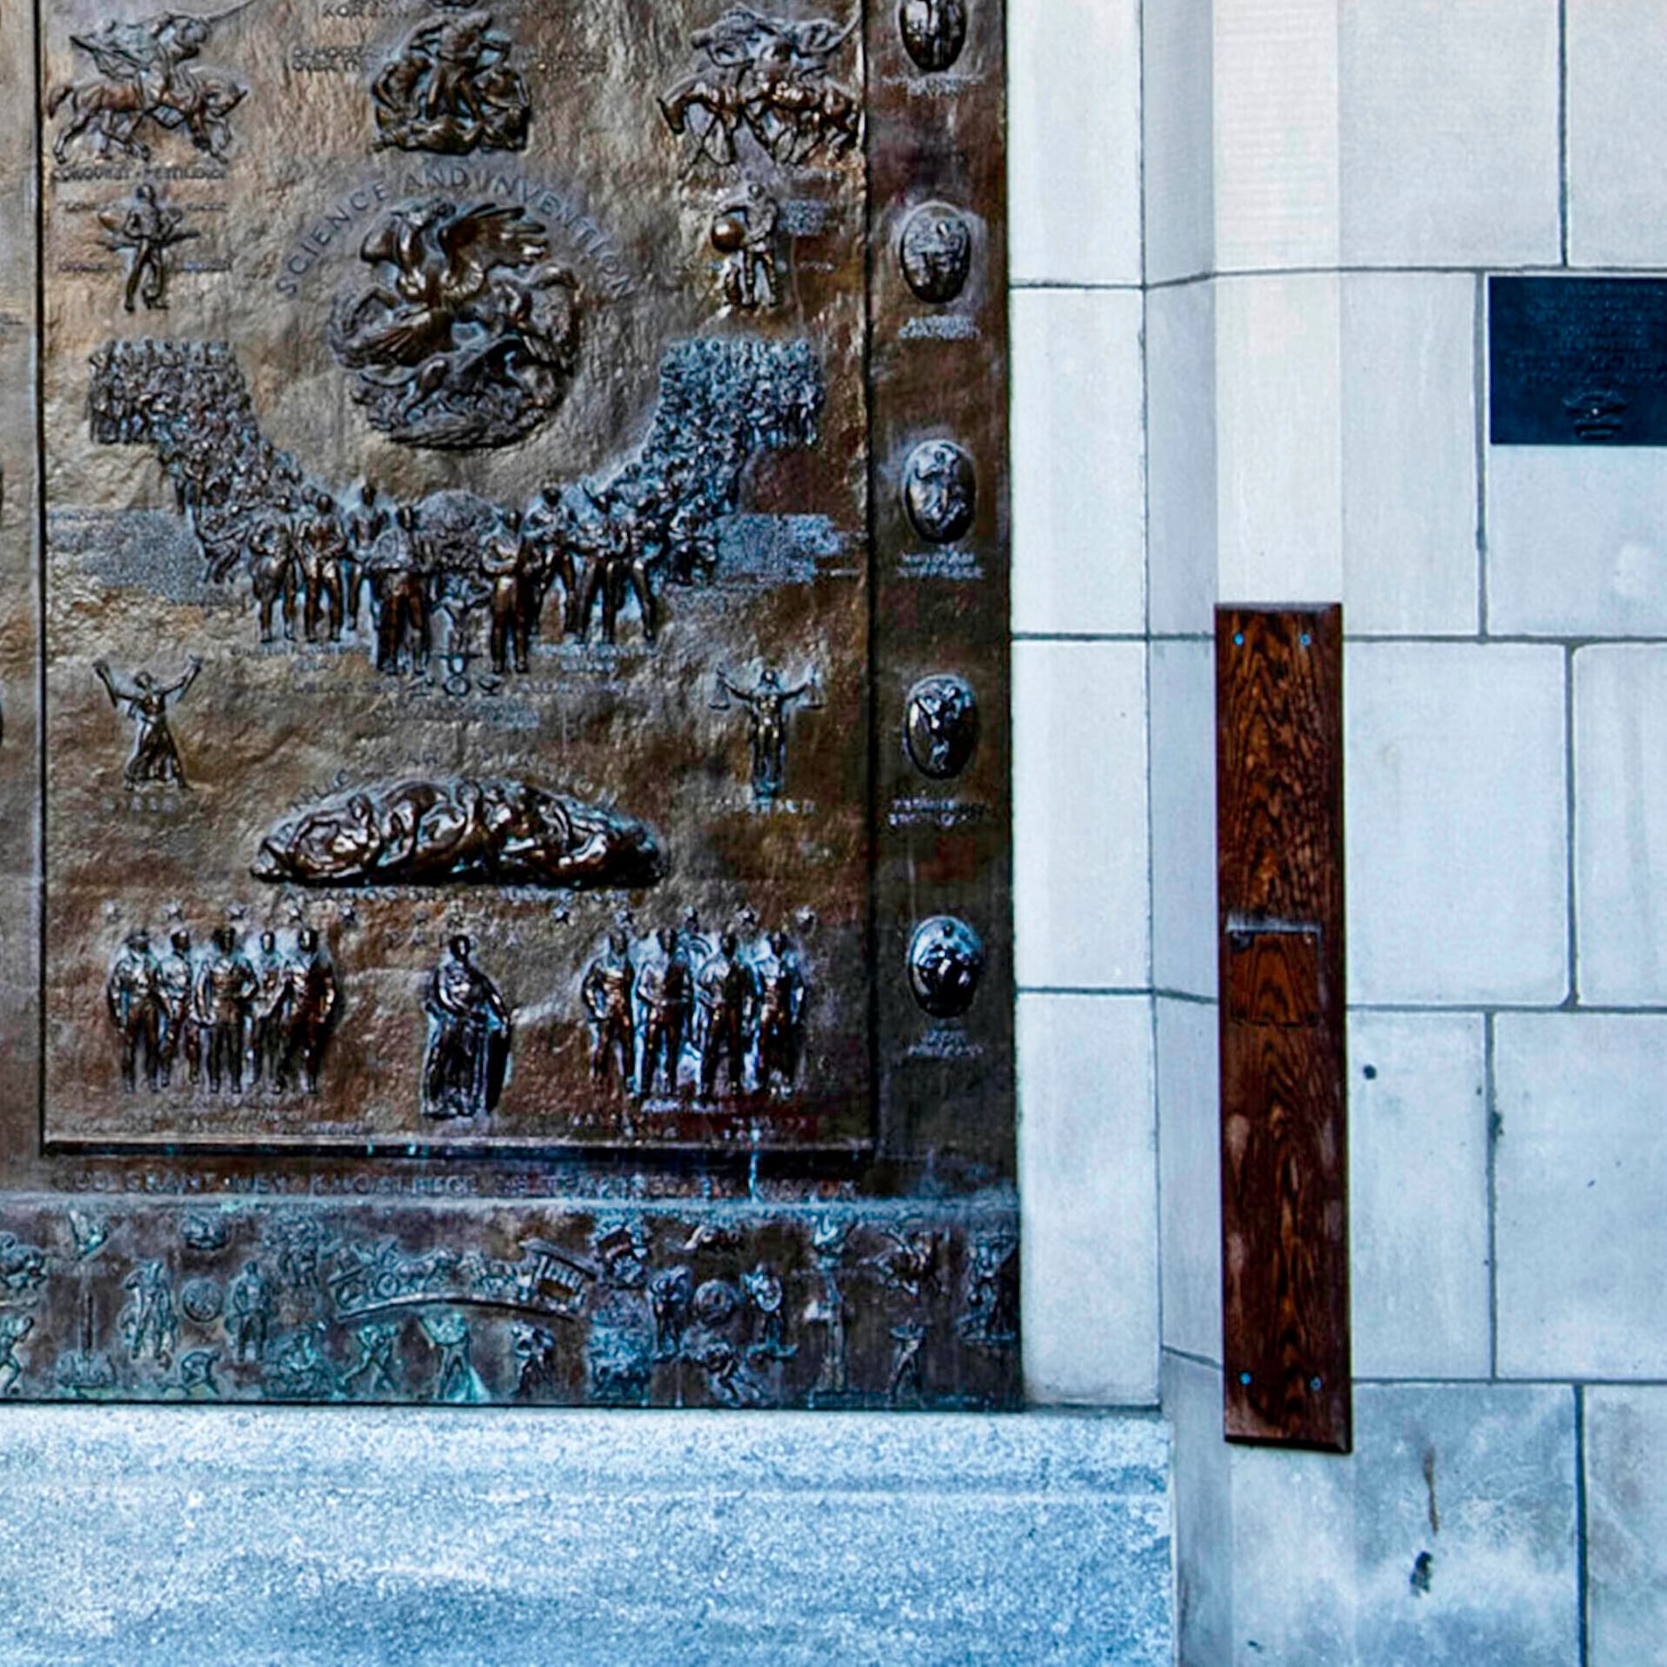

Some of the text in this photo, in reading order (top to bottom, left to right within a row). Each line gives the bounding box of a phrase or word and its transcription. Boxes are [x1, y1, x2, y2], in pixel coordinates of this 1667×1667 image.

[276, 166, 633, 300] SCIENCE AND INVENTION
